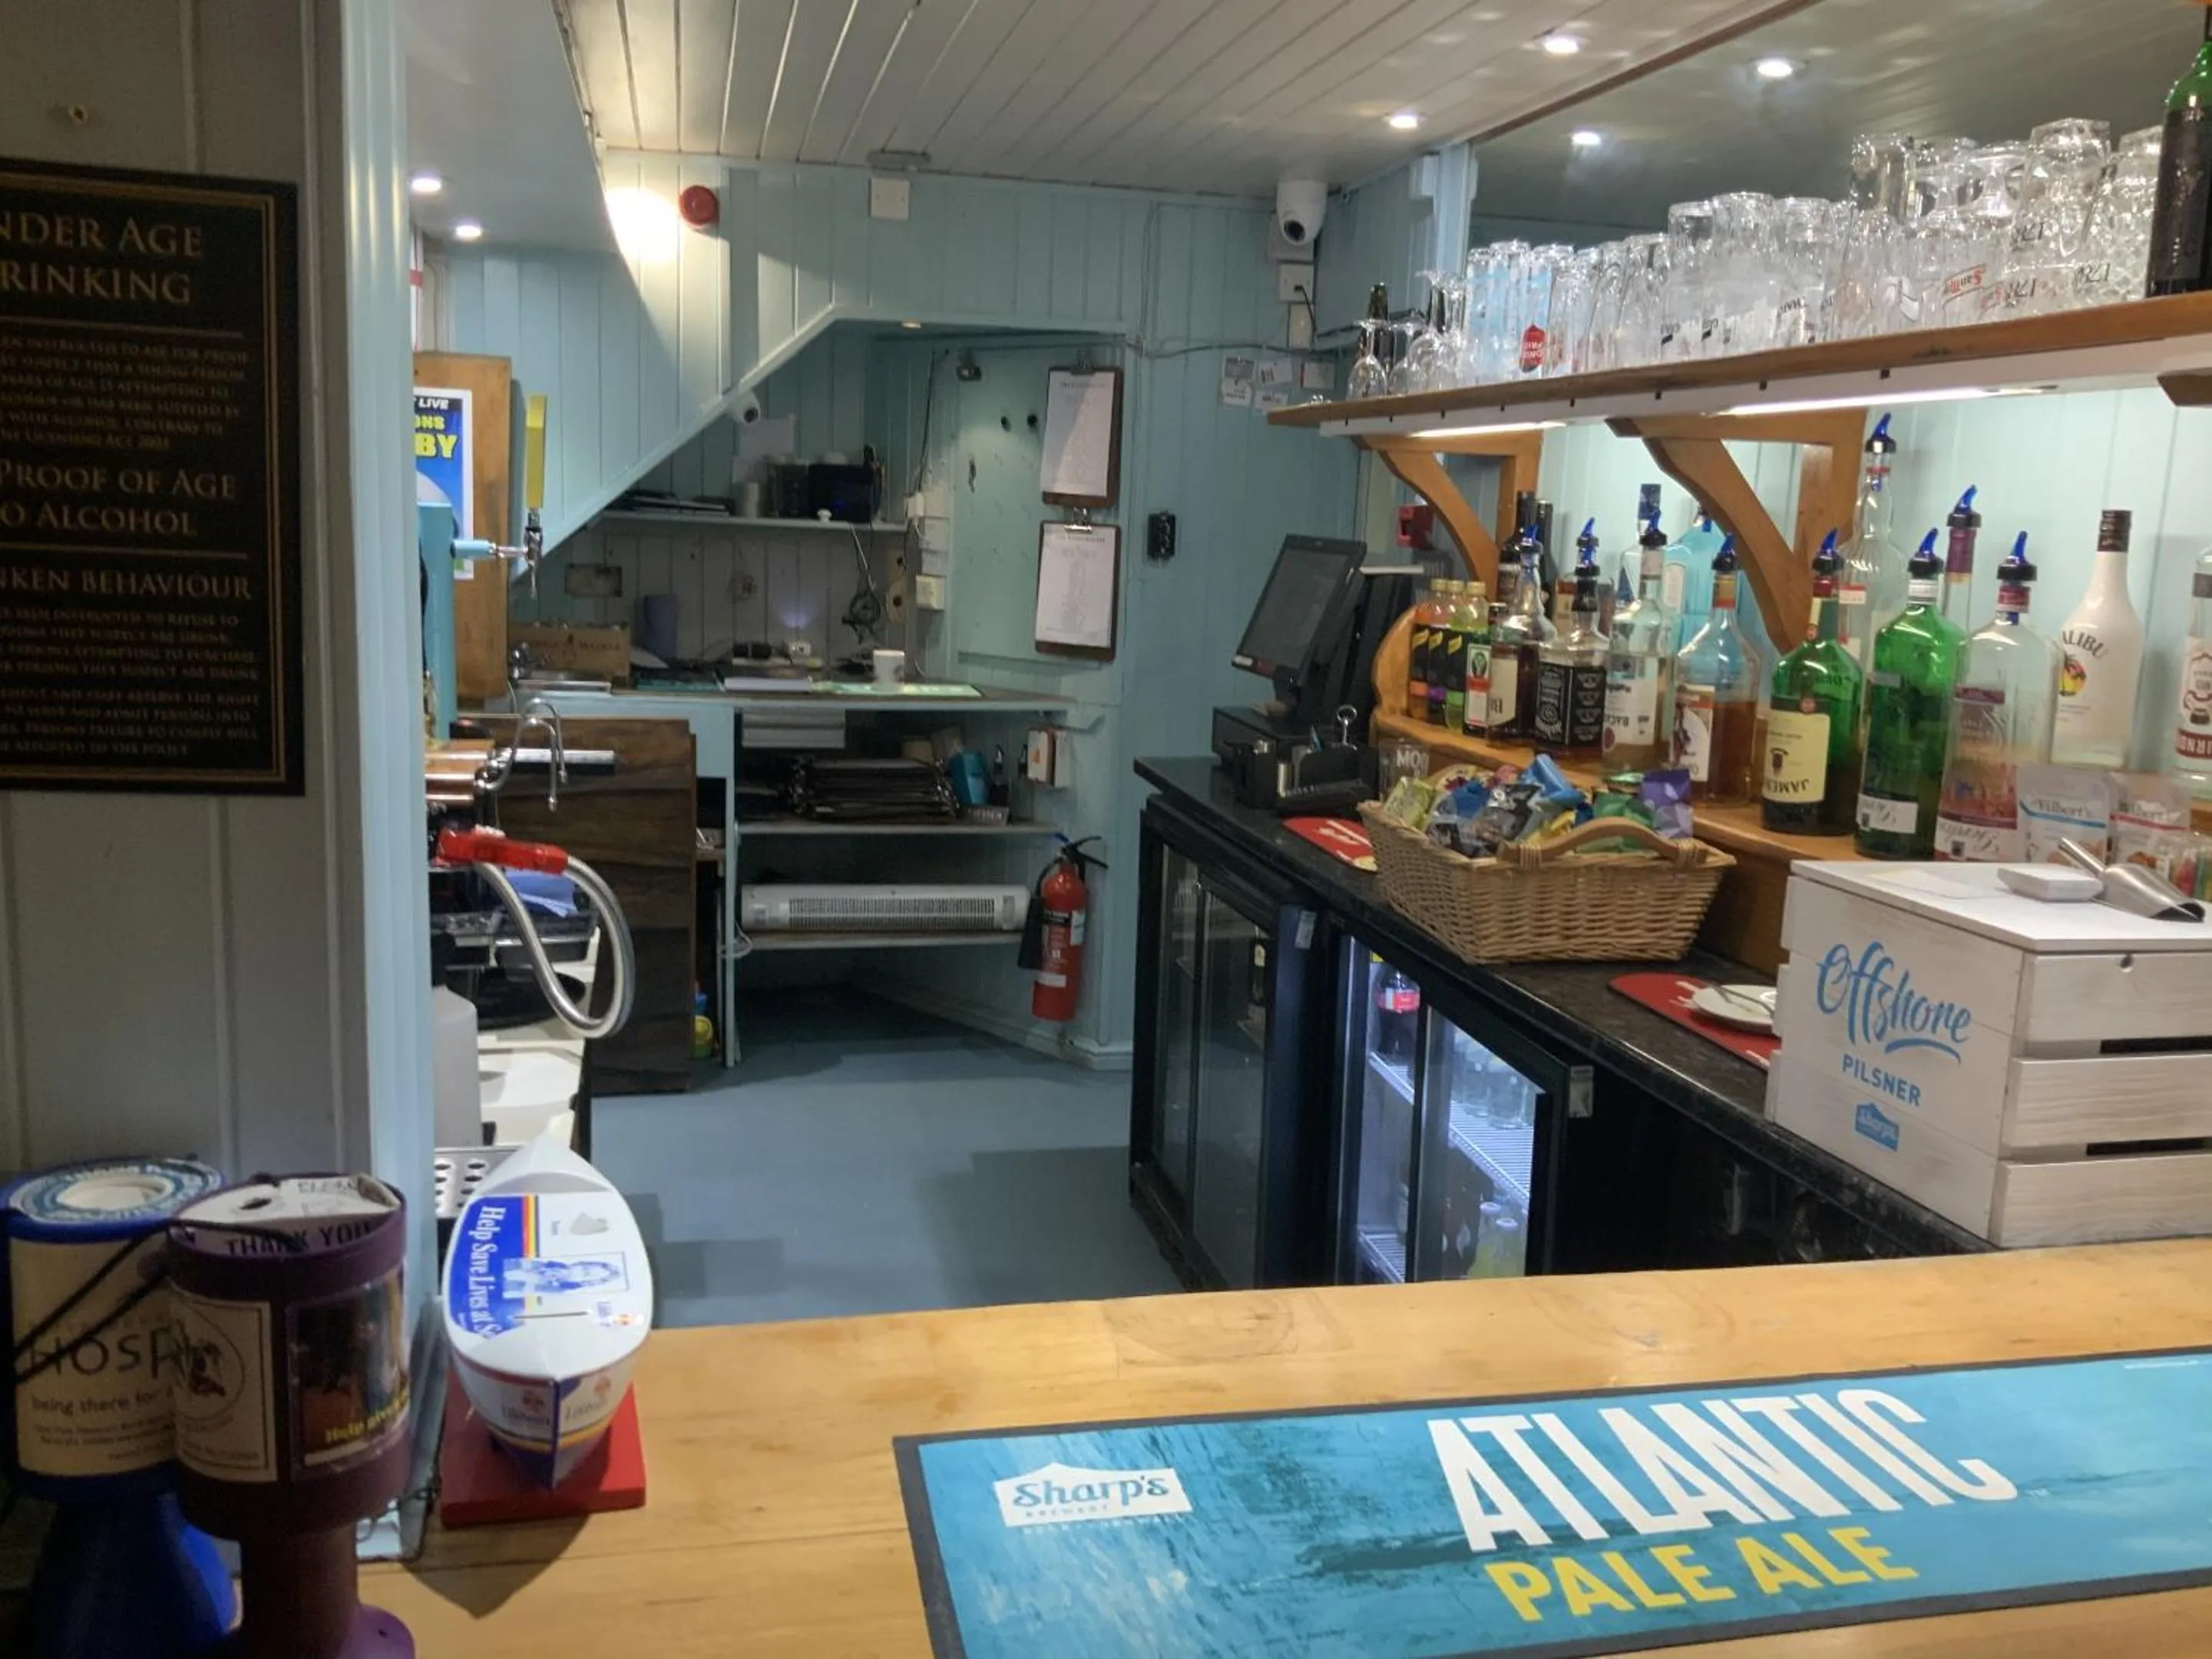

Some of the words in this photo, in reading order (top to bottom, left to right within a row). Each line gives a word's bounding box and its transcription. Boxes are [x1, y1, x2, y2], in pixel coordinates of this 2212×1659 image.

[118, 216, 203, 259] AGE
[419, 398, 449, 410] LIVE
[415, 434, 458, 459] BY
[118, 469, 160, 495] OF
[171, 468, 236, 501] AGE
[37, 501, 199, 537] ALCOHOL
[81, 570, 252, 601] BEHAVIOUR
[1816, 941, 1971, 1046] Offshore
[1843, 1053, 1920, 1107] PILSNER
[316, 1221, 372, 1248] YOU
[468, 1206, 508, 1241] Help
[469, 1242, 499, 1274] Save
[468, 1275, 497, 1309] Lives
[1426, 1390, 2020, 1553] ATLANTIC
[1012, 1475, 1169, 1509] Sharp's
[1485, 1543, 1737, 1622] PALE
[1737, 1528, 1919, 1595] ALE
